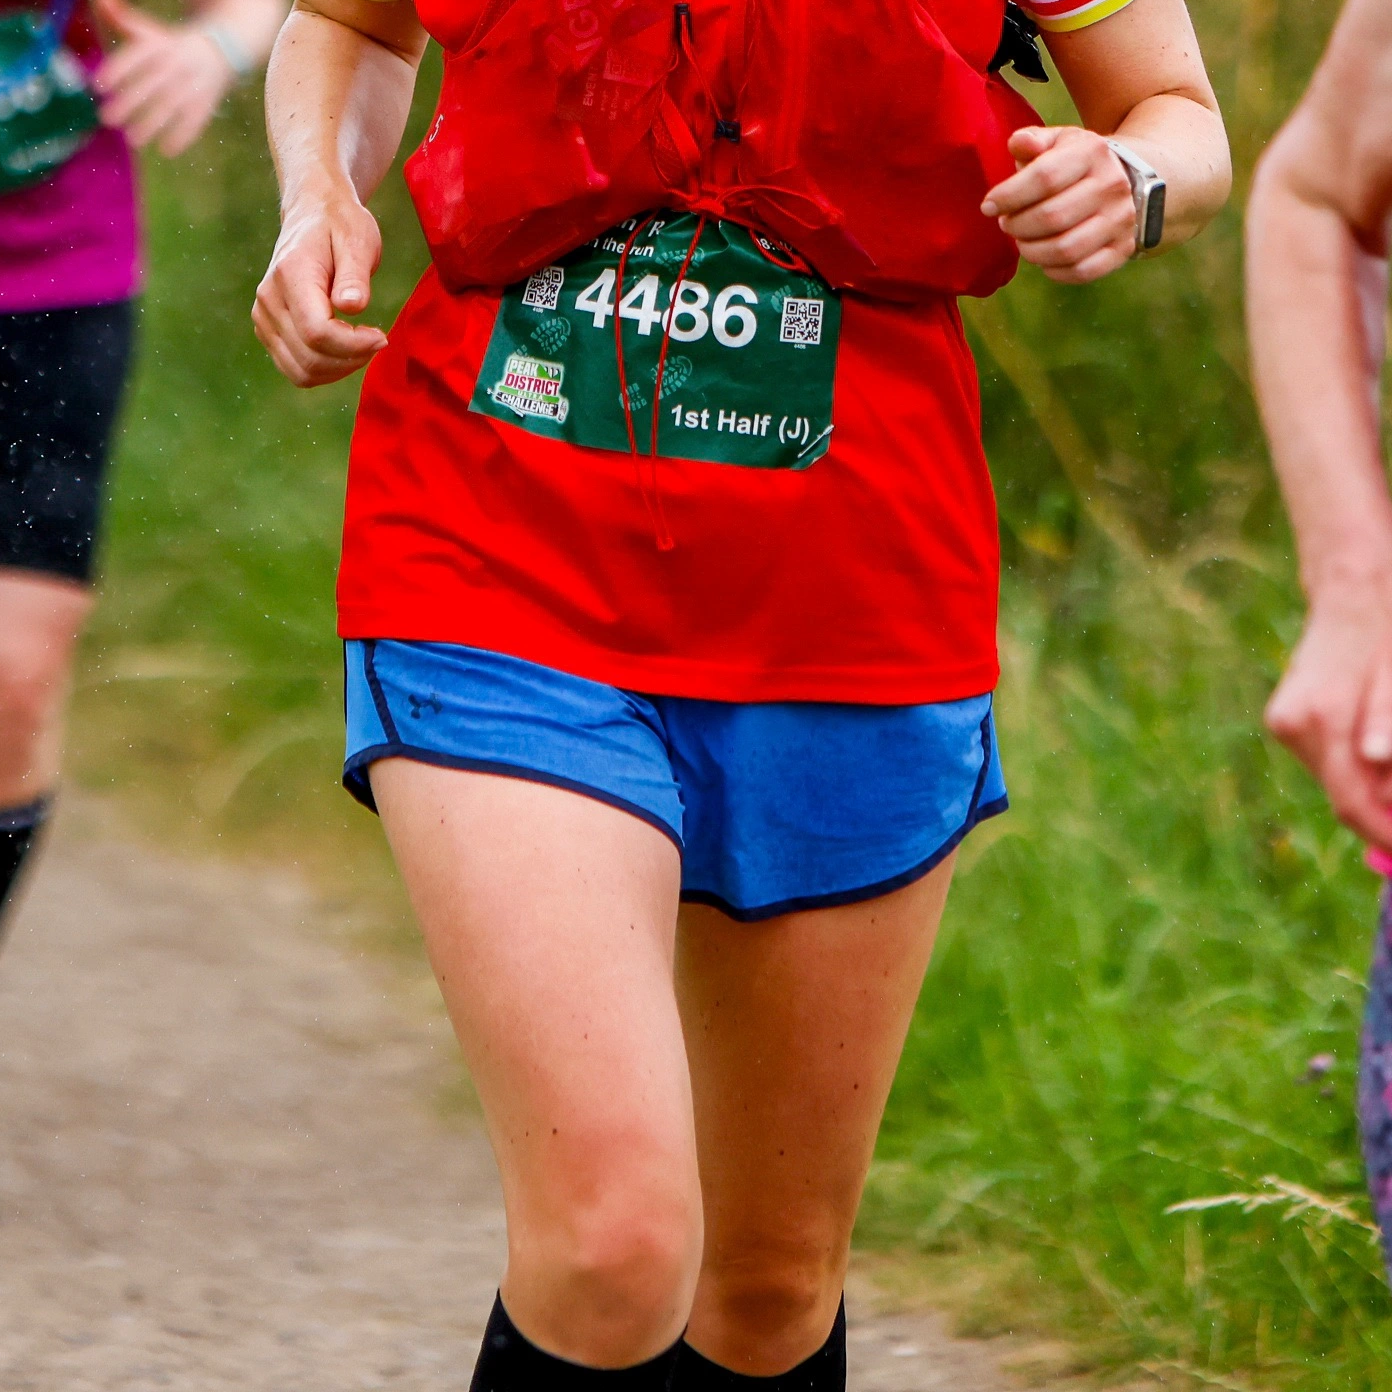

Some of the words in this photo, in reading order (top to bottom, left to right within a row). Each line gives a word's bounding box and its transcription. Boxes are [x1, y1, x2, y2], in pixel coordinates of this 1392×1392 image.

[602, 237, 626, 254] the
[628, 246, 654, 258] run
[574, 268, 757, 348] 4486
[509, 359, 540, 378] PEAK
[504, 373, 560, 397] DISTRICT
[517, 390, 544, 401] ULTRA
[500, 393, 555, 416] CHALLENGE
[670, 406, 710, 431] 1st
[717, 412, 770, 438] Half
[778, 417, 810, 445] (J)
